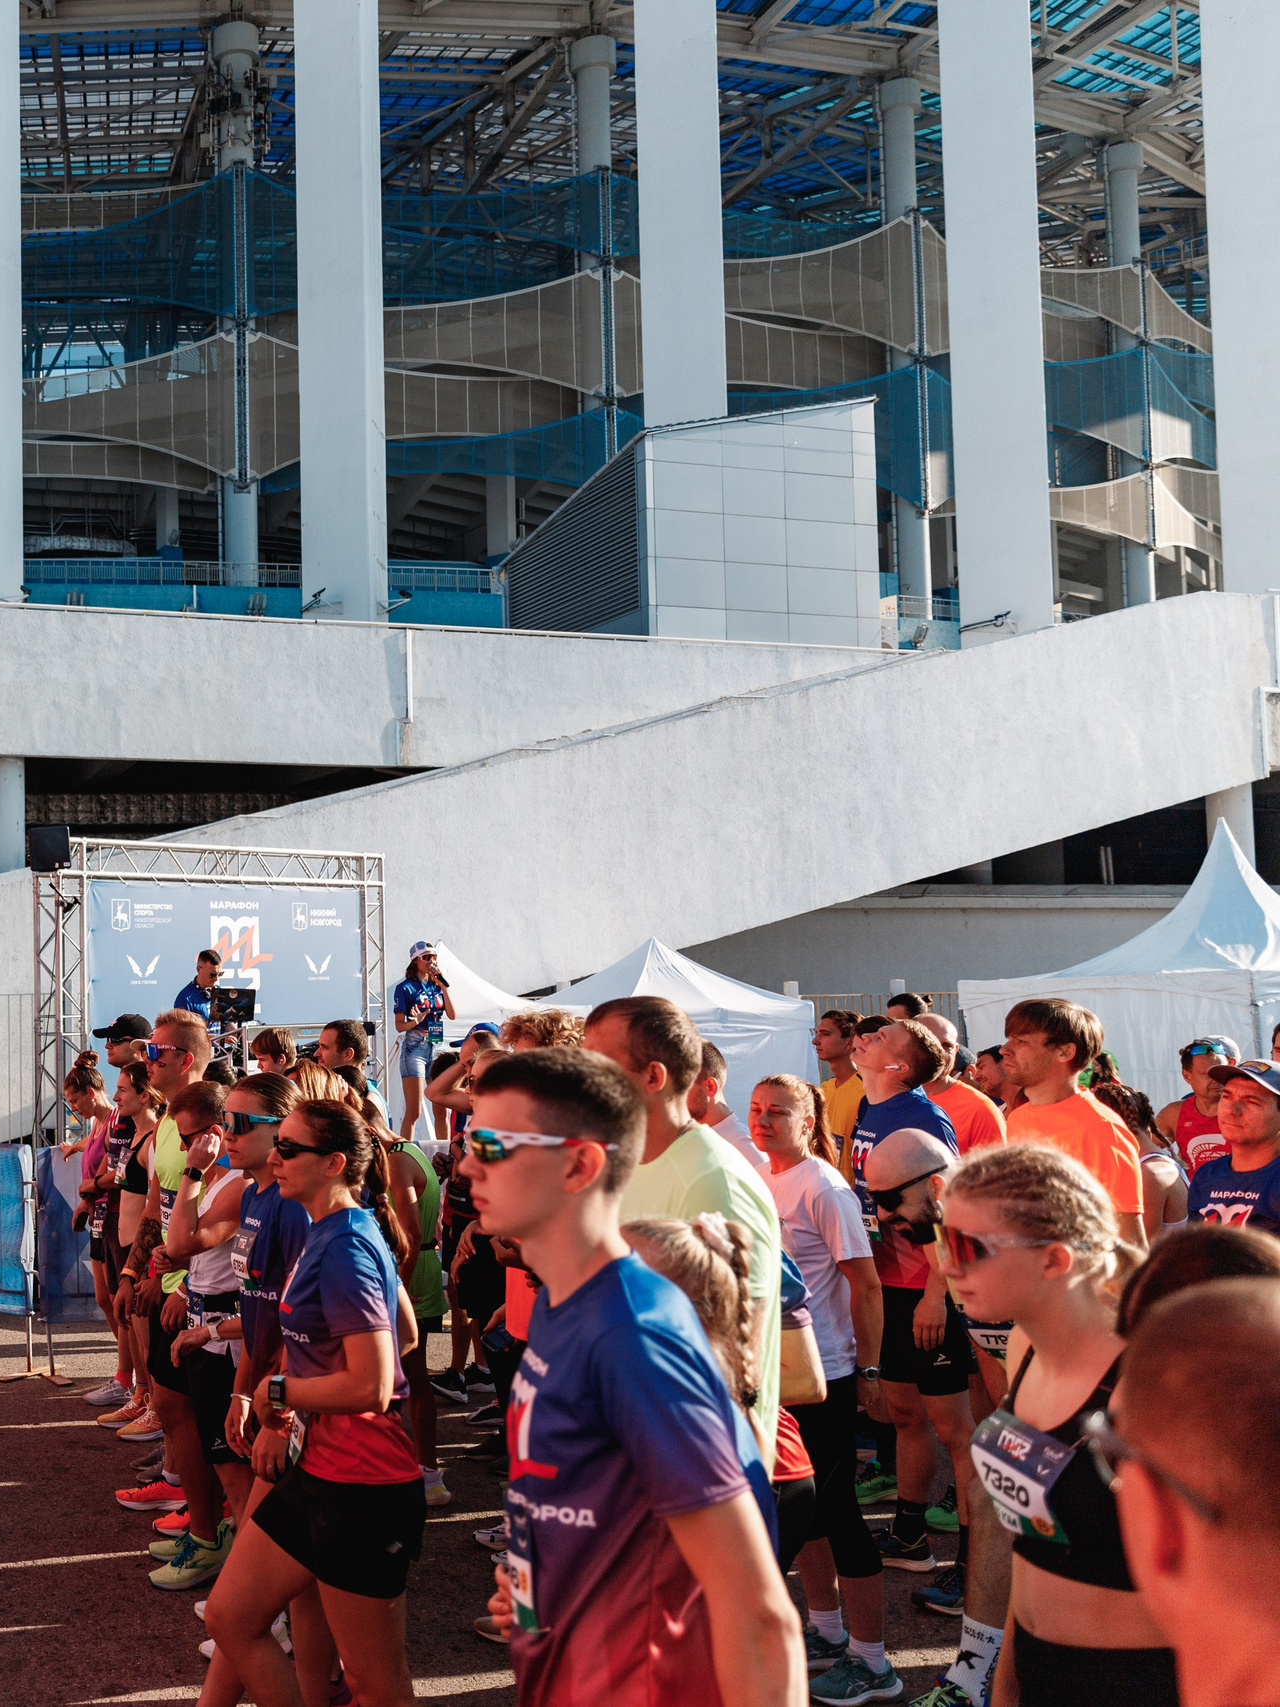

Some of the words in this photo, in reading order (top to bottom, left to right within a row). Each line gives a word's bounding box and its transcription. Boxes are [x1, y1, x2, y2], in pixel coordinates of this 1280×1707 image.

[209, 901, 259, 910] МАРАФОН
[310, 907, 337, 917] НИЖНИЙ
[310, 918, 343, 928] НОВГОРОД
[981, 1460, 1030, 1509] 7320
